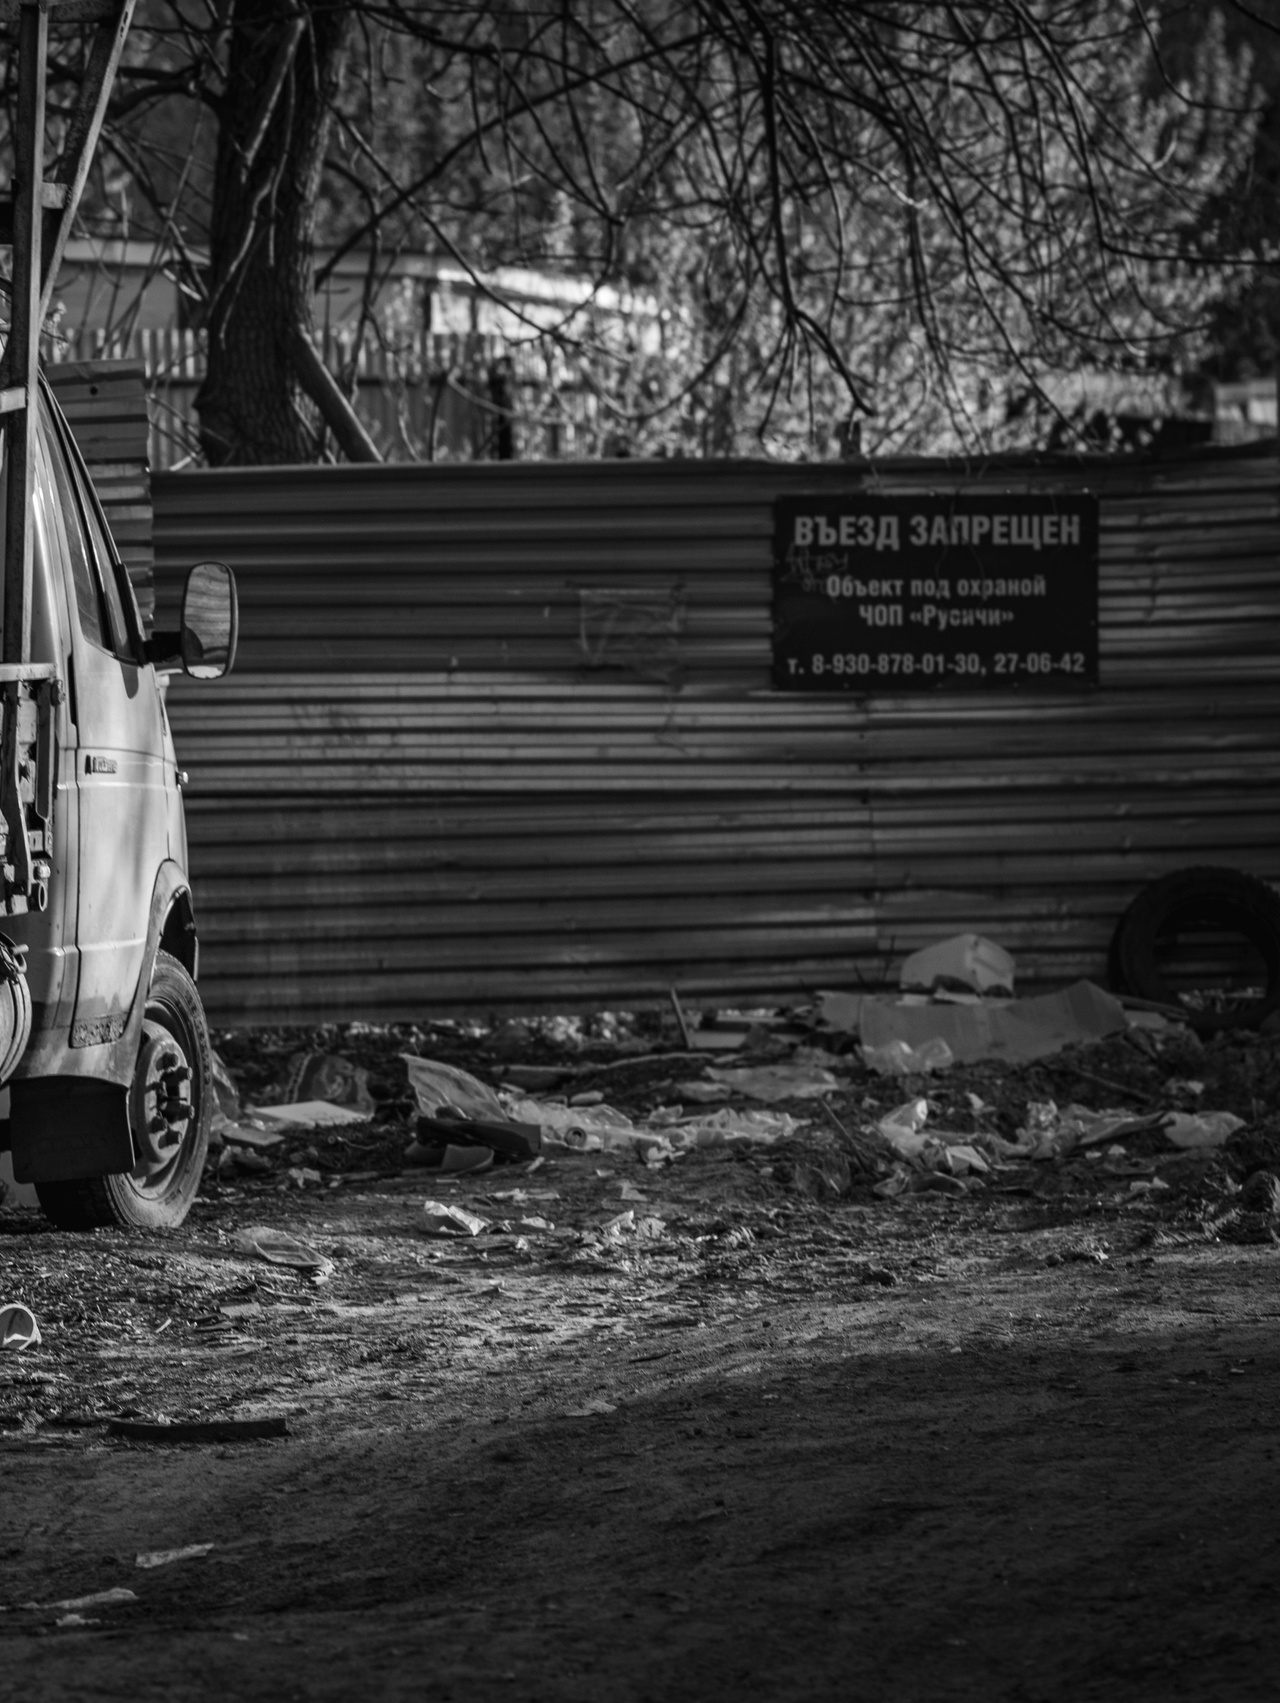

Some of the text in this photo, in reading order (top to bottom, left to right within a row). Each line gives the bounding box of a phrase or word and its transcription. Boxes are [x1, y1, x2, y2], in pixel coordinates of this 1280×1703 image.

[794, 514, 1081, 551] ВЪЕЗД ЗАПРЕЩЕН
[826, 574, 1047, 600] Объект под охраной
[859, 604, 1015, 631] ЧОП «Русичи»
[787, 652, 1086, 676] т. 8-930-878-01-30, 27-06-42
